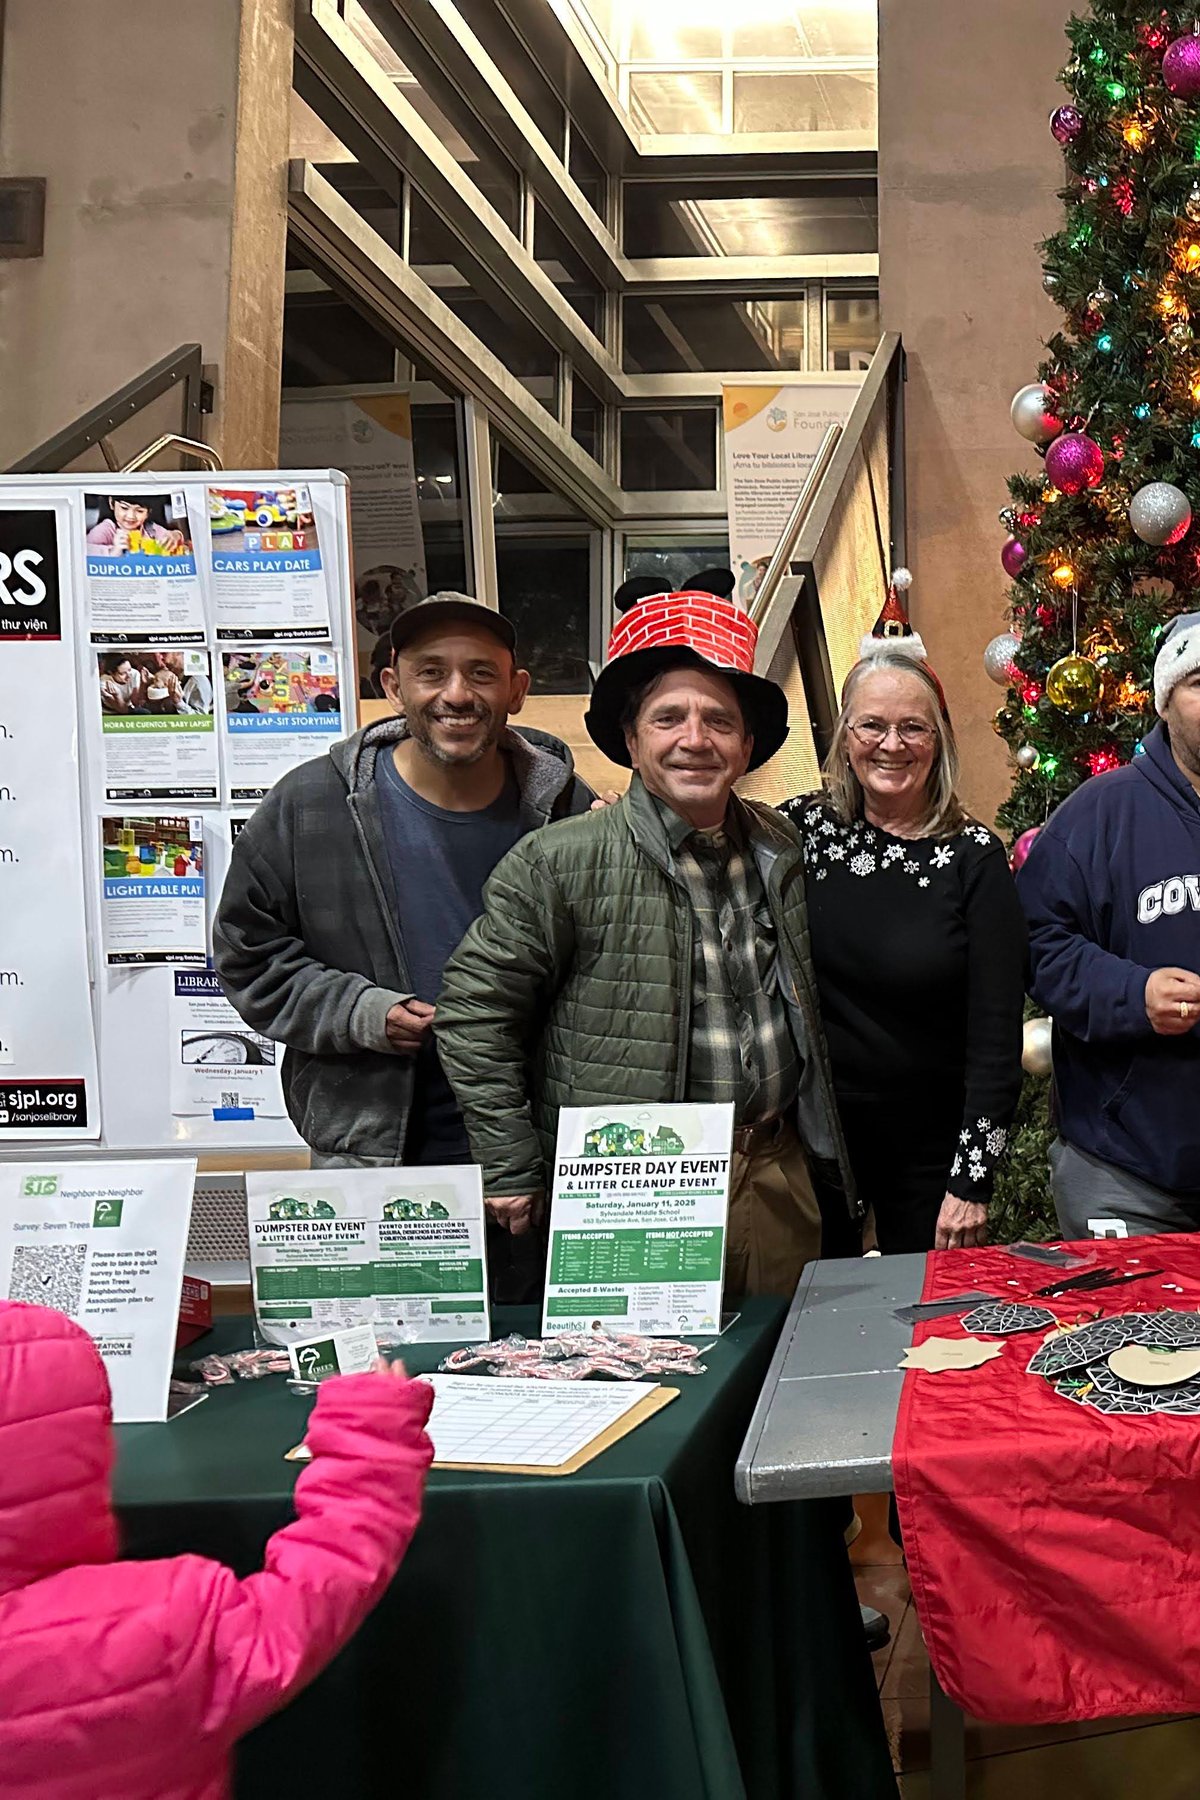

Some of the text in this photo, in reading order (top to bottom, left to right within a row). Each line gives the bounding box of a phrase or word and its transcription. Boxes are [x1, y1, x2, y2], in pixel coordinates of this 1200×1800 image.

[249, 536, 304, 548] PLAY
[89, 563, 191, 576] DUPLO PLAY DATE
[214, 559, 310, 571] CARS PLAY DATE
[136, 721, 167, 729] CUENTOS
[229, 717, 339, 726] BABY LAP-SIT STORYTIME
[106, 885, 201, 896] LIGHT TABLE PLAY
[177, 976, 219, 988] LIBRAR
[8, 1089, 77, 1110] sjpl.org
[11, 1112, 77, 1123] /sanjoselibrary
[558, 1159, 728, 1177] DUMPSTER DAY EVENT
[566, 1177, 718, 1190] & LITTER CLEANUP EVENT
[60, 1188, 144, 1200] Neighbor-to-Neighbor
[585, 1201, 625, 1210] Saturday,
[626, 1200, 659, 1209] January
[661, 1200, 672, 1208] 11,
[13, 1221, 91, 1232] Survey: Seven Trees
[255, 1221, 366, 1234] DUMPSTER DAY EVENT
[413, 1221, 456, 1229] RECOLECCIÓN
[582, 1232, 615, 1240] ACCEPTED
[665, 1231, 680, 1239] NOT
[680, 1230, 713, 1238] ACCEPTED
[123, 1269, 138, 1277] help
[88, 1287, 136, 1296] Neighborhood
[557, 1286, 591, 1294] Accepted
